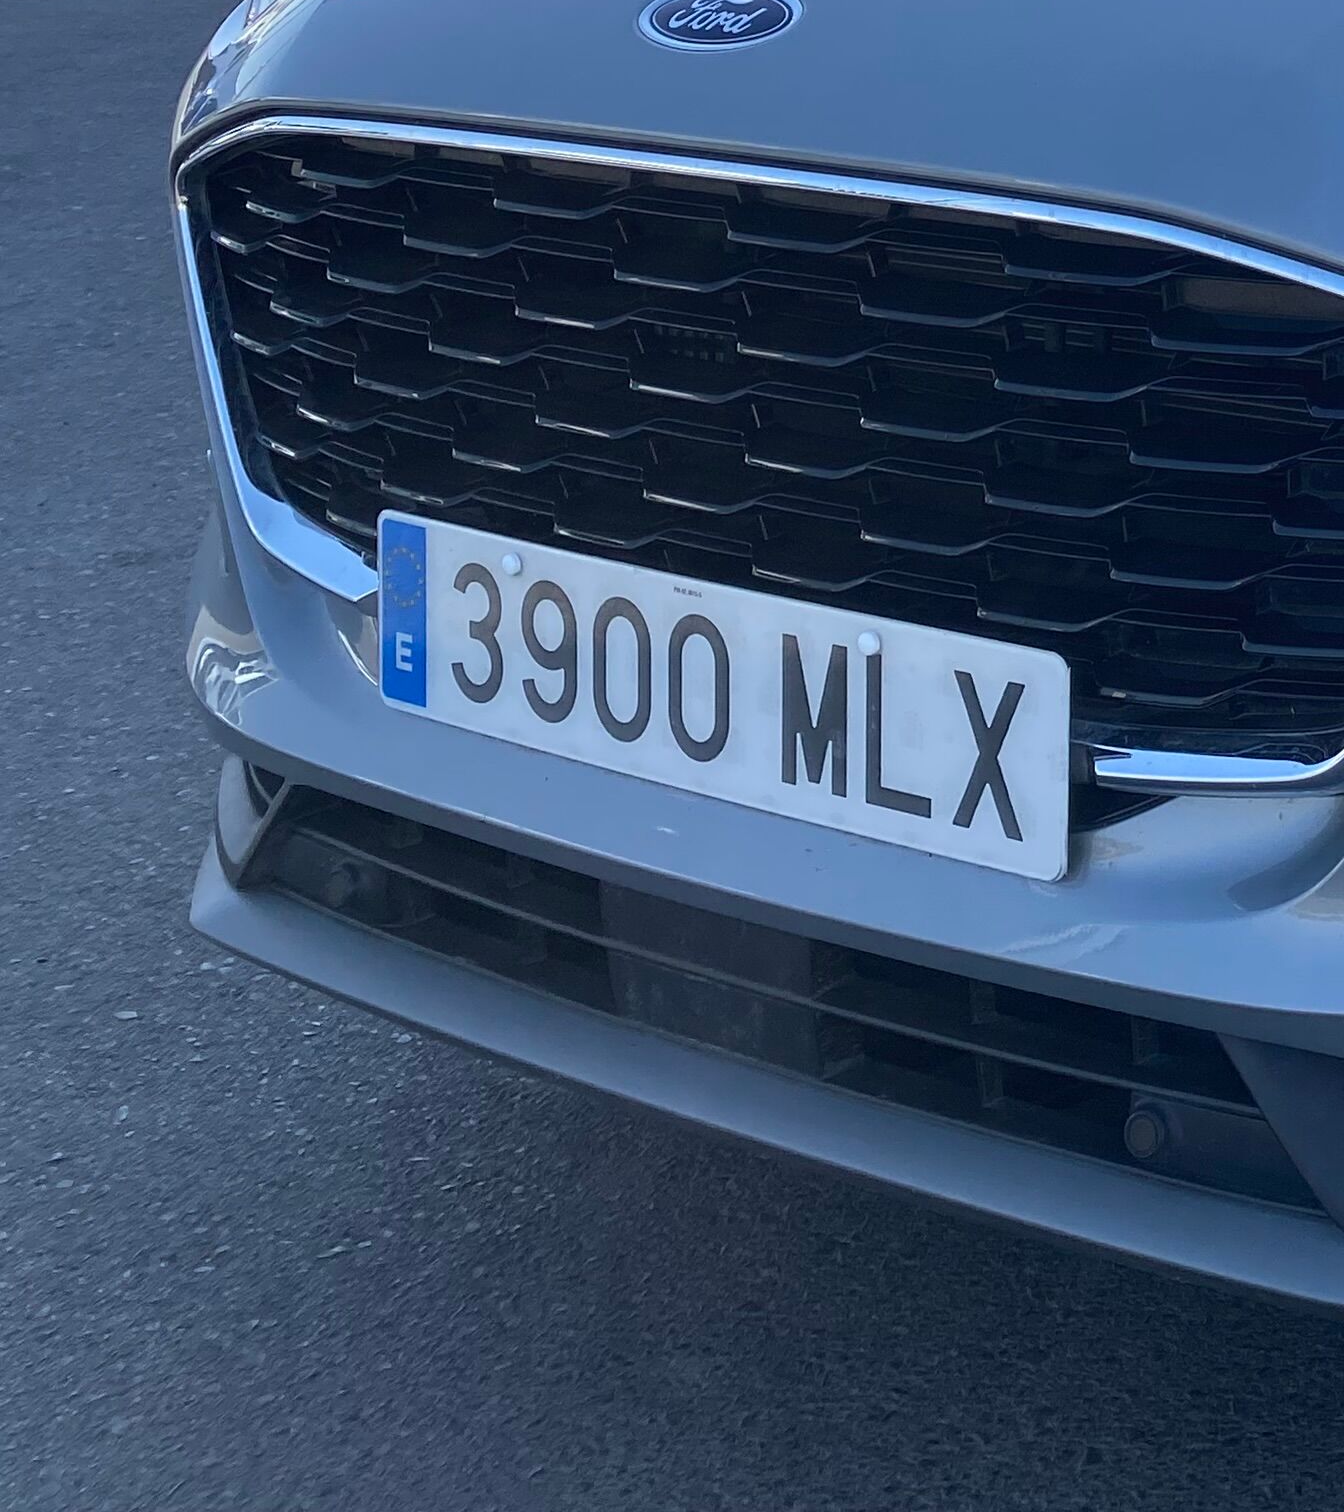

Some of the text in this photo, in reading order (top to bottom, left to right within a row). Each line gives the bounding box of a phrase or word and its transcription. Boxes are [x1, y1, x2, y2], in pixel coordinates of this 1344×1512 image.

[396, 631, 413, 673] E
[450, 561, 1026, 843] 3900 MLX
